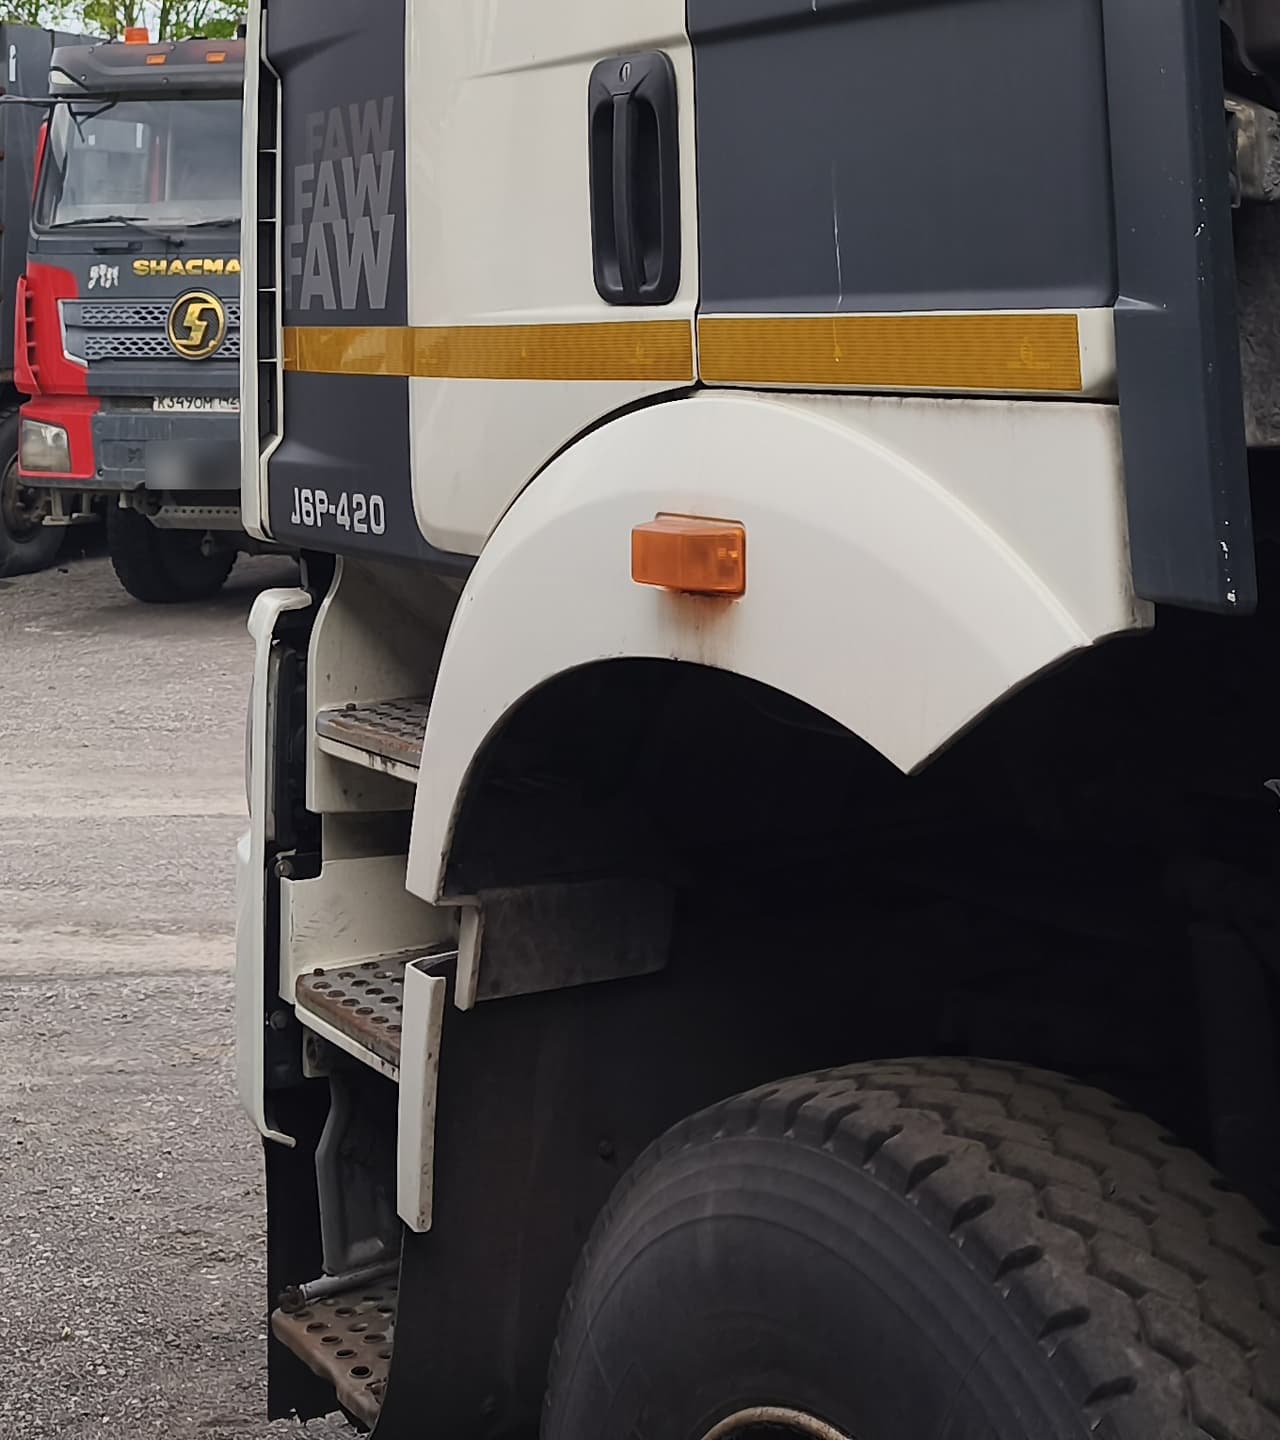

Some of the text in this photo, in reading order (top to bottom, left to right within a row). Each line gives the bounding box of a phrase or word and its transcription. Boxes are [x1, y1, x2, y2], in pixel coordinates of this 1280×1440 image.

[305, 96, 394, 168] FAW
[294, 150, 395, 234] FAW
[132, 259, 240, 276] SHACMA
[285, 214, 395, 310] FAW
[291, 487, 385, 535] J6P-420
